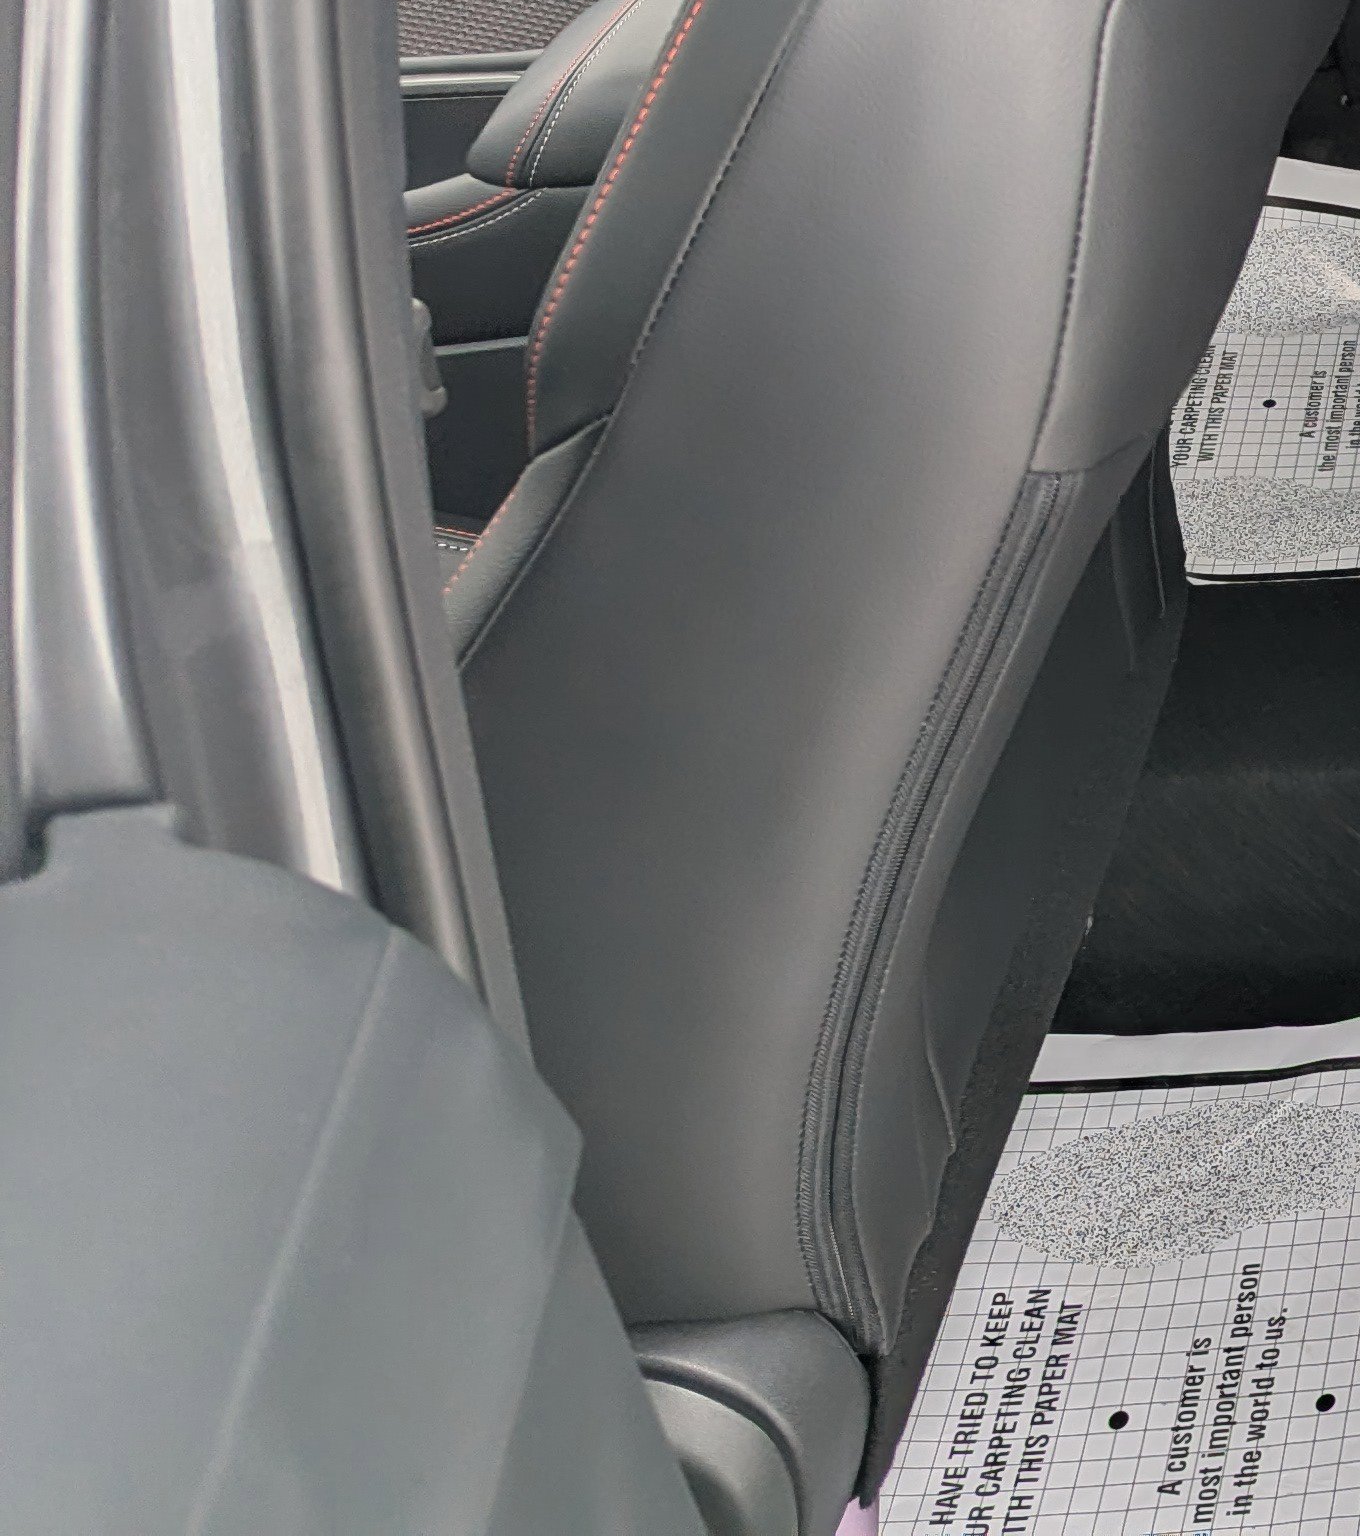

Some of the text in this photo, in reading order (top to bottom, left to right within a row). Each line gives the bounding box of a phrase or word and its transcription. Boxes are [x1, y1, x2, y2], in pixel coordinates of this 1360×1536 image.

[1170, 437, 1194, 468] YOUR
[1179, 377, 1208, 434] CARPETING
[1197, 350, 1239, 462] WITH THIS PAPER MAT
[1299, 430, 1316, 439] A
[1304, 381, 1325, 428] customer
[1318, 340, 1358, 472] the most important person
[928, 1292, 1014, 1525] HAVE TRIED TO KEEP
[965, 1289, 1052, 1536] UR CARPETING CLEAN
[1001, 1300, 1084, 1533] ITH THIS PAPER MAT
[1157, 1337, 1212, 1496] A customer is
[1193, 1263, 1261, 1524] most important person
[1226, 1307, 1288, 1517] in the world to us.
